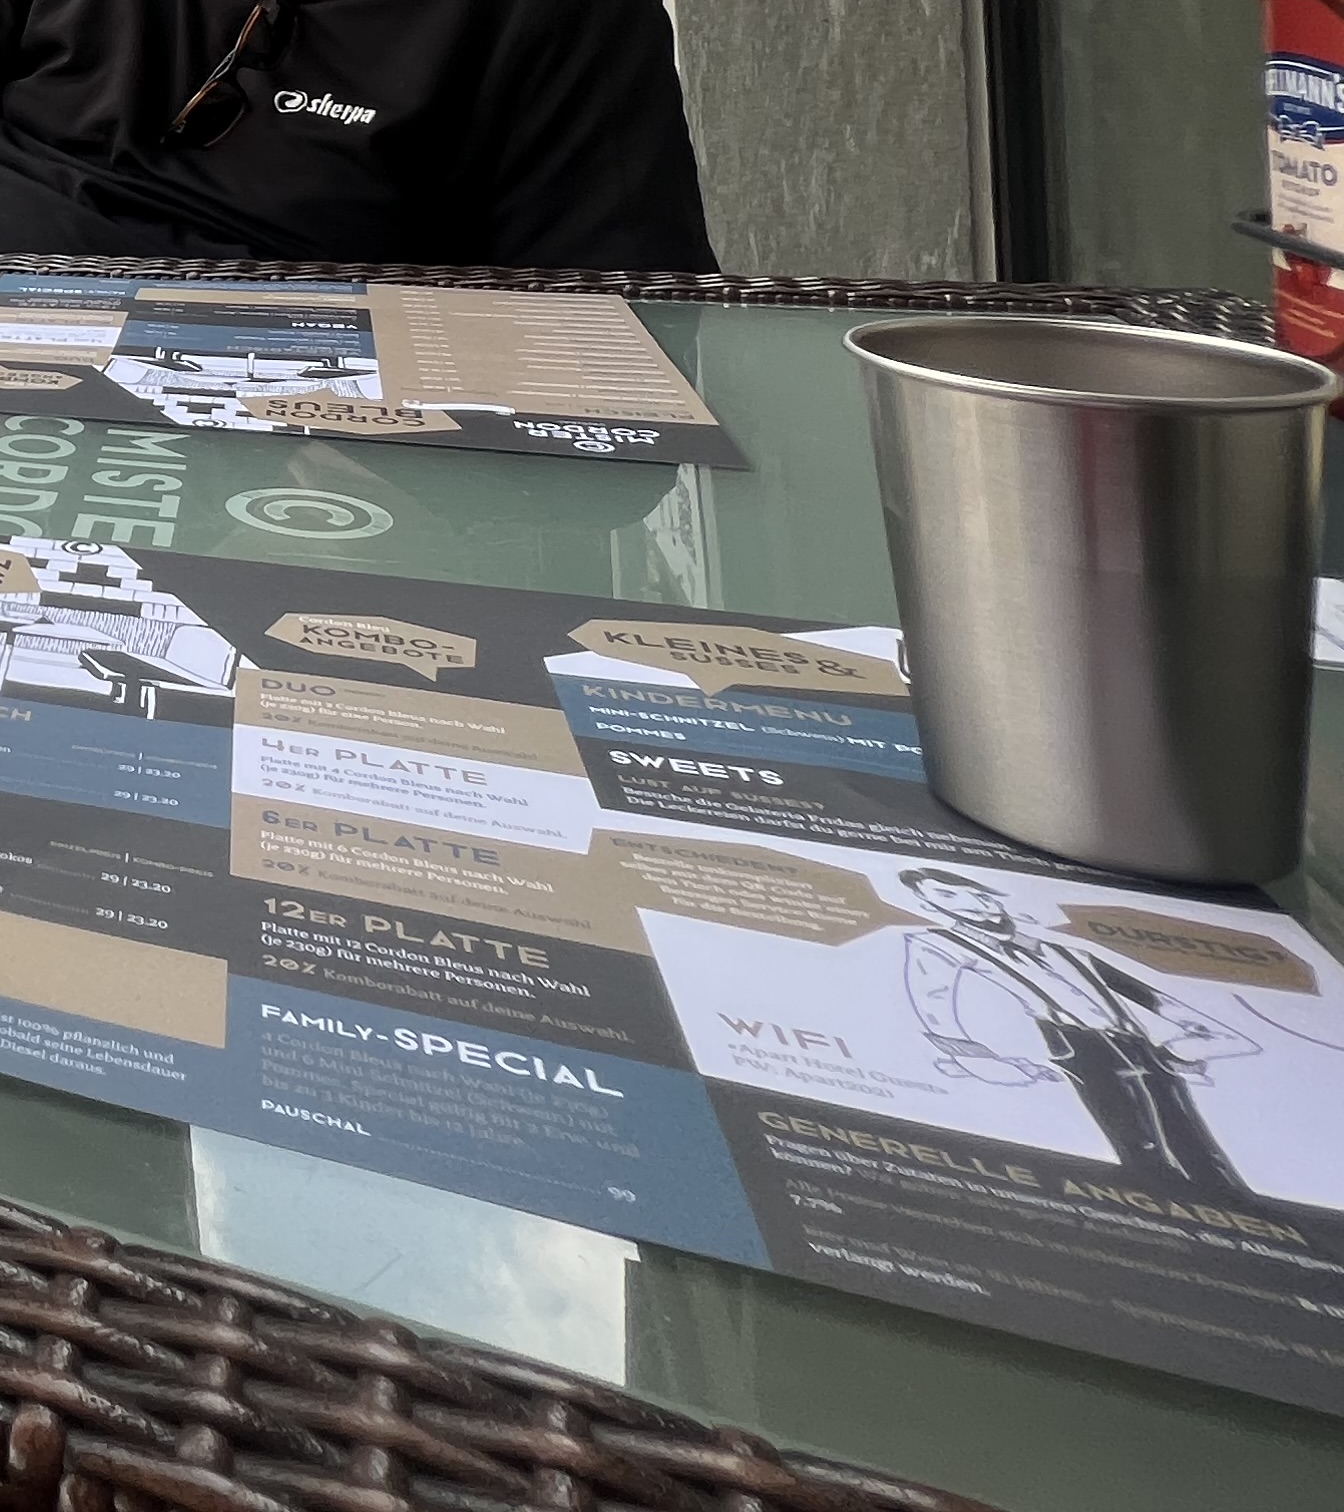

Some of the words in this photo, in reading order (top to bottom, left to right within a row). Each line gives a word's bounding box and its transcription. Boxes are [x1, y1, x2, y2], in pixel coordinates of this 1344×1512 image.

[305, 92, 378, 126] sherpa
[265, 408, 426, 427] CORDON
[268, 398, 423, 419] BLEUS
[513, 420, 660, 438] CORDON
[527, 428, 655, 445] MISTER
[70, 427, 193, 548] MISTE
[299, 636, 464, 665] ANGEBOTE
[302, 623, 454, 650] KOMBO-
[603, 630, 809, 665] KLEINES
[815, 658, 866, 680] &
[260, 677, 337, 697] DUO
[588, 705, 755, 732] MINI-SCHNITZEL
[845, 736, 886, 749] MIT
[595, 721, 686, 741] POMMES
[261, 737, 320, 758] 4ER
[334, 748, 487, 786] PLATTE
[609, 750, 783, 785] SWEETS
[261, 809, 318, 833] 6ER
[333, 821, 500, 867] PLATTE
[259, 829, 305, 846] Platte
[307, 839, 334, 851] mit
[349, 845, 410, 865] Cordon
[412, 857, 459, 875] Bleus
[461, 868, 505, 884] nach
[505, 875, 554, 893] Wahl
[328, 851, 353, 865] für
[355, 858, 424, 878] mehrere
[100, 871, 120, 884] 29
[130, 877, 172, 894] 23.20
[95, 906, 115, 919] 29
[126, 913, 169, 930] 23.20
[263, 897, 347, 928] 12ER
[363, 914, 549, 969] PLATTE
[260, 920, 310, 939] Platte
[312, 932, 341, 946] mit
[345, 938, 362, 950] 12
[363, 941, 431, 964] Cordon
[433, 955, 484, 975] Bleus
[487, 967, 535, 986] nach
[536, 976, 591, 998] Wahl
[260, 932, 282, 947] (je
[285, 938, 333, 957] 230g)
[336, 947, 362, 963] für
[364, 955, 440, 979] mehrere
[443, 969, 535, 998] Personen.
[261, 953, 316, 975] 20%
[322, 967, 442, 1002] Komborabatt
[446, 996, 479, 1010] auf
[481, 1001, 536, 1021] deine
[61, 1030, 140, 1056] pflanzlich
[142, 1049, 175, 1065] und
[261, 1004, 622, 1097] FAMILY-SPECIAL
[717, 1012, 853, 1059] WIFI
[43, 1038, 84, 1056] seine
[86, 1047, 186, 1081] Lebensdauer
[261, 1098, 370, 1137] PAUSCHAL
[758, 1111, 1038, 1187] GENERELLE
[1062, 1179, 1305, 1244] ANGABEN
